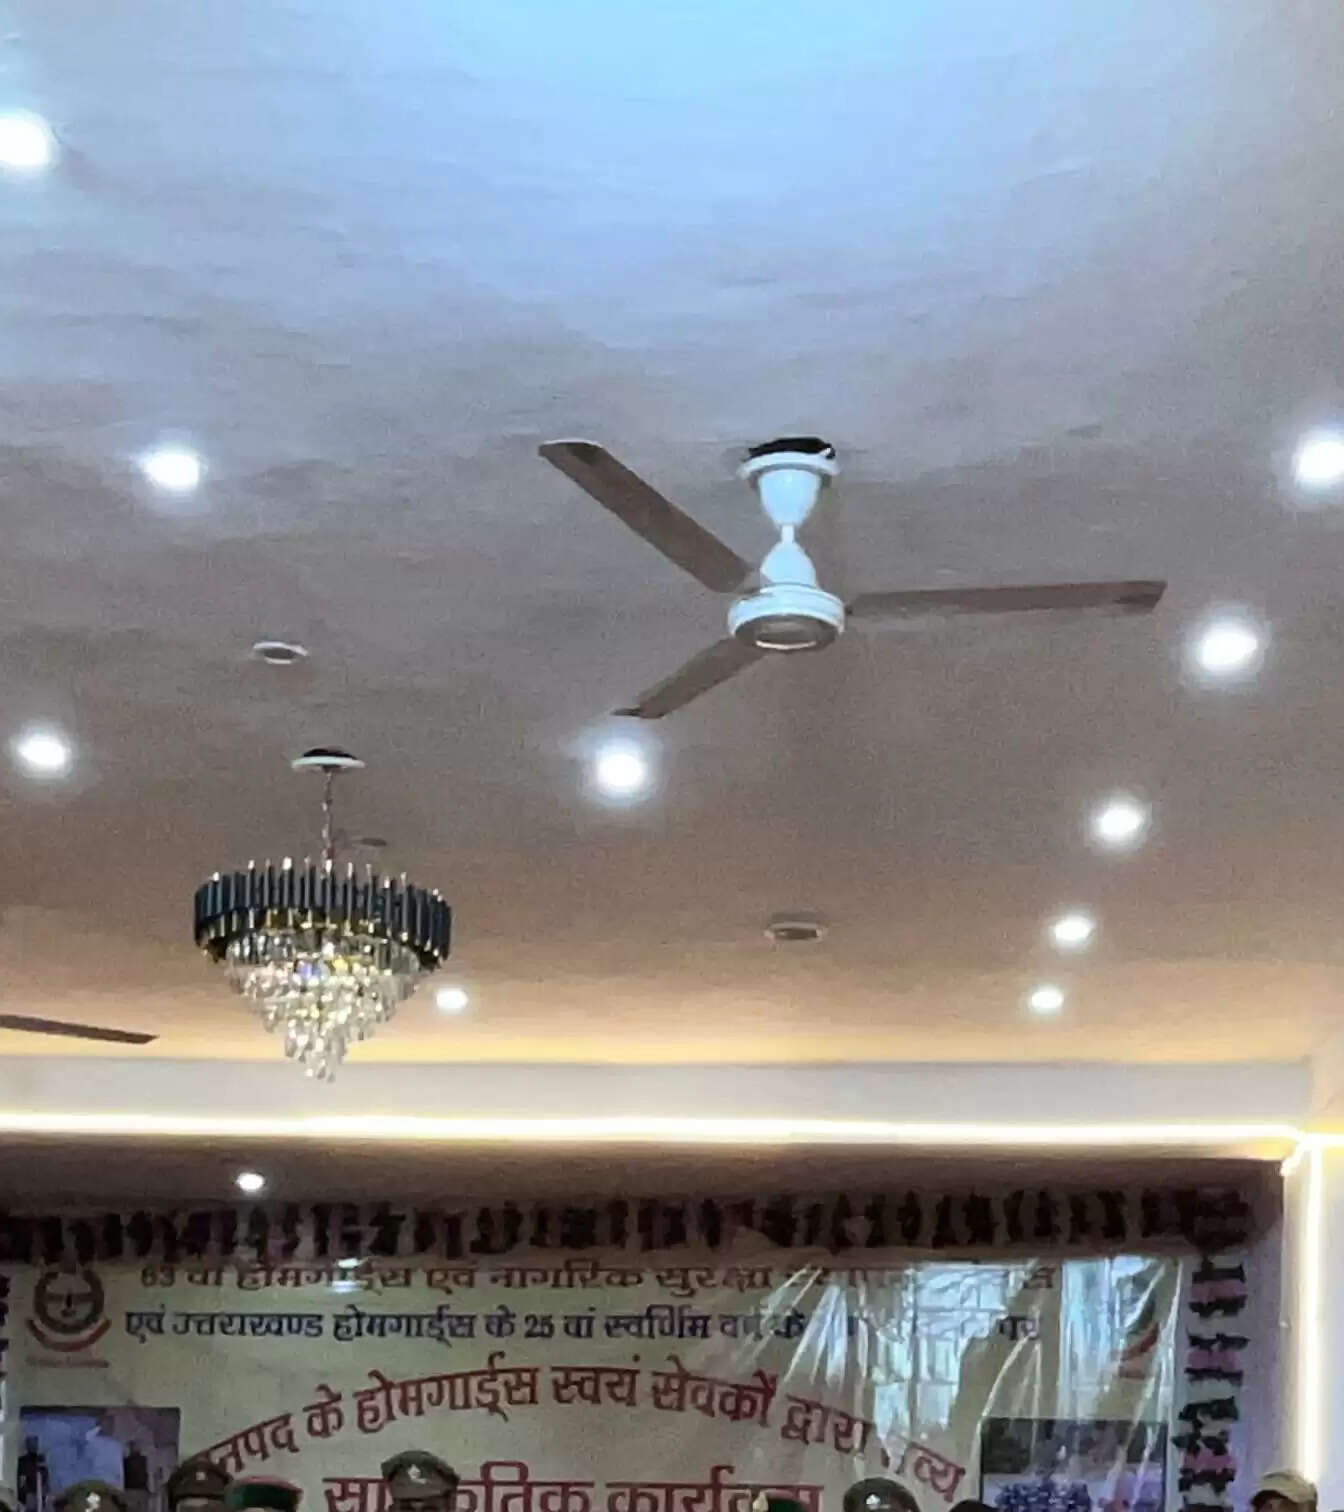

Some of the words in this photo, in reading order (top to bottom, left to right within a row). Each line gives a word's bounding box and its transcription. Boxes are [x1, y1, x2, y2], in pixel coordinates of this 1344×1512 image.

[490, 1258, 644, 1289] नागरिक
[125, 1304, 165, 1344] एवं
[172, 1311, 323, 1338] उत्तराखण्ड
[332, 1303, 475, 1348] होमगार्ड्स
[484, 1304, 517, 1339] के
[524, 1313, 554, 1339] 25
[564, 1306, 596, 1339] वां
[196, 1412, 300, 1474] नपद
[302, 1383, 346, 1439] के
[352, 1351, 540, 1434] होमगार्ड्स
[551, 1354, 641, 1407] स्वयं
[651, 1354, 778, 1430] सेवकों
